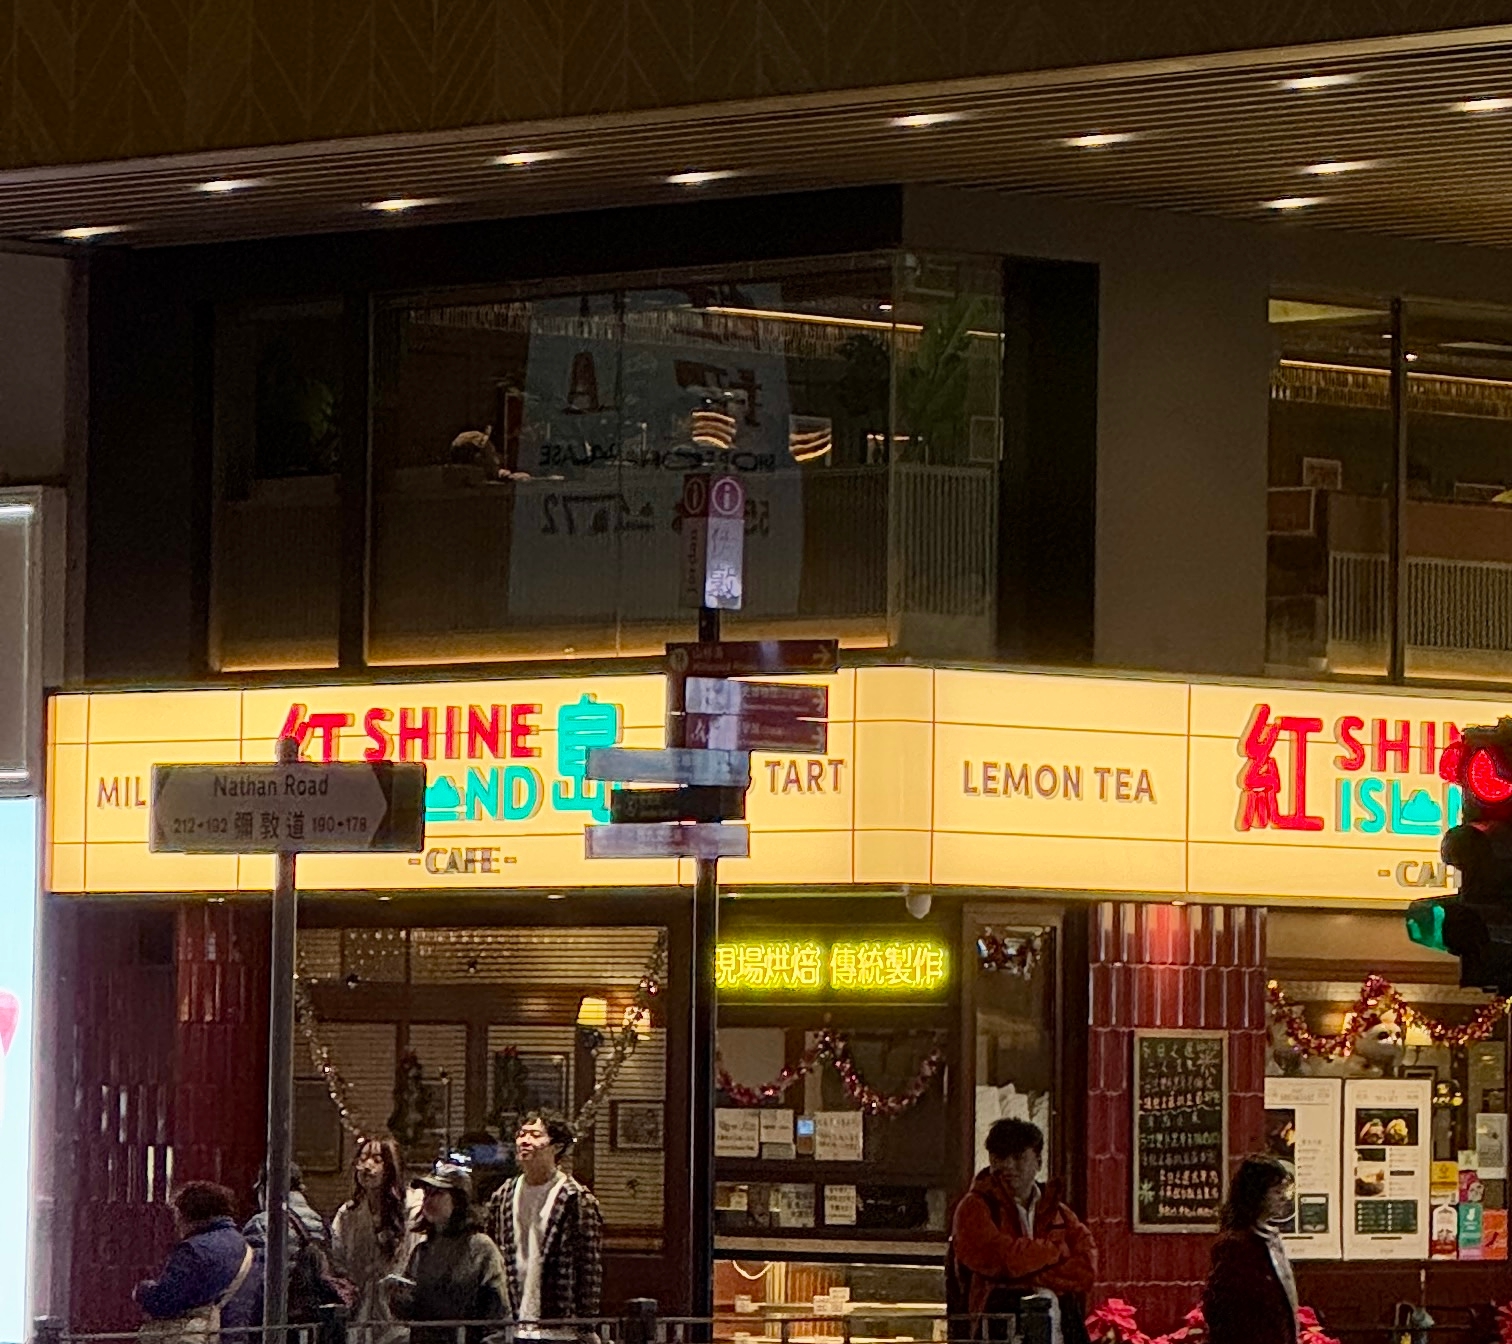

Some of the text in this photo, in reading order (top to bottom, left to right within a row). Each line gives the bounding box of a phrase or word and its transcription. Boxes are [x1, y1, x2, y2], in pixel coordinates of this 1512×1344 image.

[362, 703, 543, 762] SHINE
[1335, 715, 1464, 775] SHI
[213, 774, 329, 797] Nathan Road
[764, 758, 846, 795] TART
[963, 759, 1158, 804] LEMON TEA
[1236, 703, 1325, 832] 紅
[97, 776, 148, 808] MIL
[714, 942, 945, 988] 現場烘焙 傳統製作
